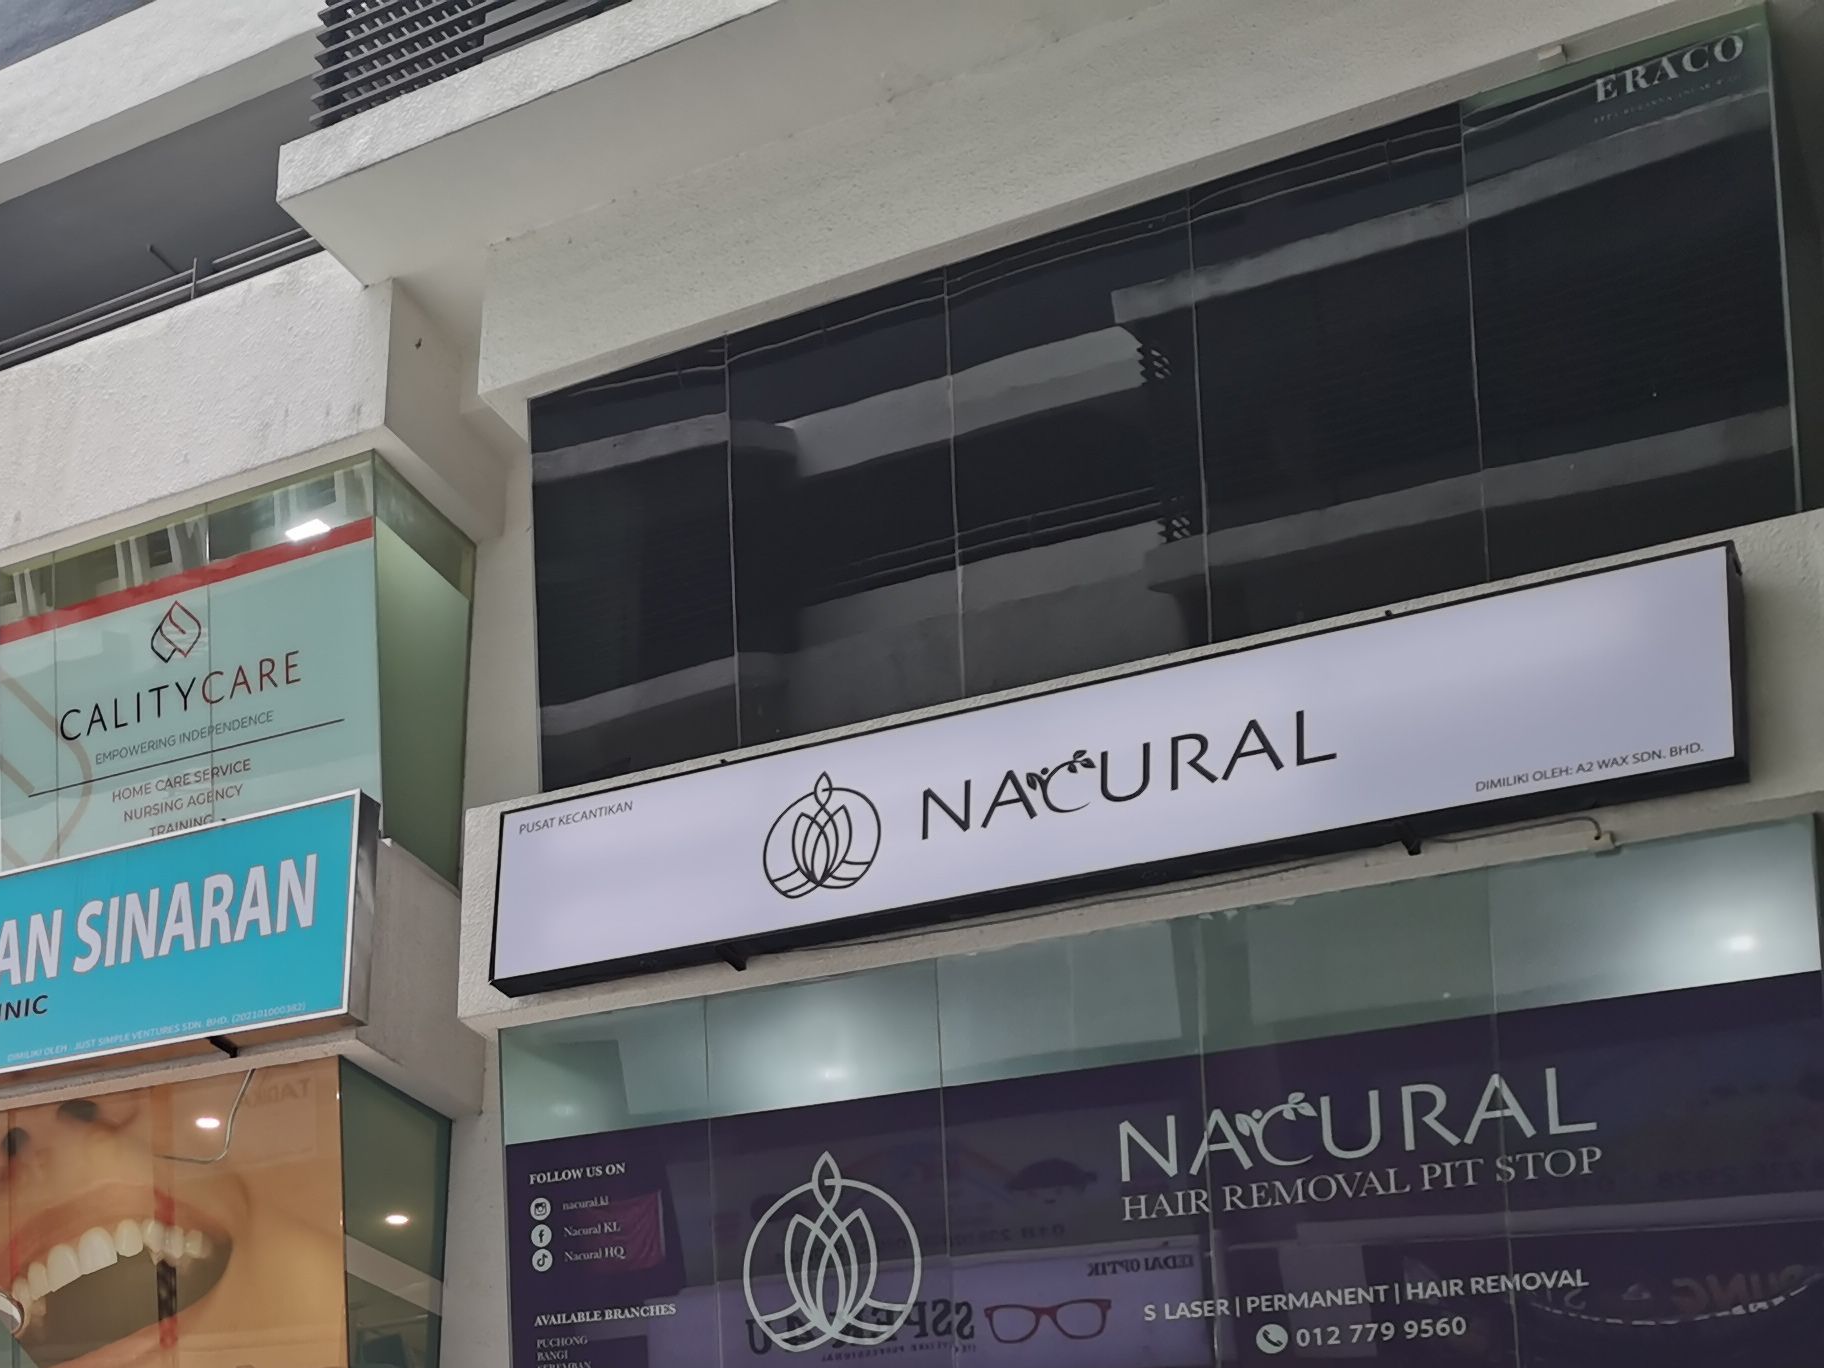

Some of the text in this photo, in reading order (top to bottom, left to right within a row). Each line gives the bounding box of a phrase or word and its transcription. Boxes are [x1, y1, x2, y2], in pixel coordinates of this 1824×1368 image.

[1595, 34, 1744, 103] ERACO
[60, 650, 301, 740] CALITYCARE
[95, 710, 274, 765] EMPOWERING INDEPENDENCE
[112, 758, 251, 803] HOME CARE SERVICE
[1475, 741, 1704, 792] DIMILIKI OLEH: A2 WAX SDN. BHD.
[124, 784, 244, 822] NURSING AGENCY
[519, 800, 634, 834] PUSAT KECANTIKAN
[149, 814, 213, 836] TRAINING
[72, 853, 317, 974] SINARAN
[98, 1033, 129, 1047] SIMPLE
[131, 1024, 180, 1041] VENTURES
[529, 1162, 626, 1185] FOLLOW US ON
[1121, 1146, 1603, 1221] HAIR REMOVAL PIT STOP
[563, 1221, 621, 1238] Nacural KL
[564, 1246, 626, 1263] Nacural HQ
[1164, 1269, 1590, 1320] LASER PERMANENT HAIR REMOVAL
[534, 1303, 677, 1327] AVAILABLE BRANCHES
[1296, 1316, 1467, 1347] 012 779 9560
[536, 1335, 588, 1349] PUCHONG
[537, 1349, 569, 1362] BANGI
